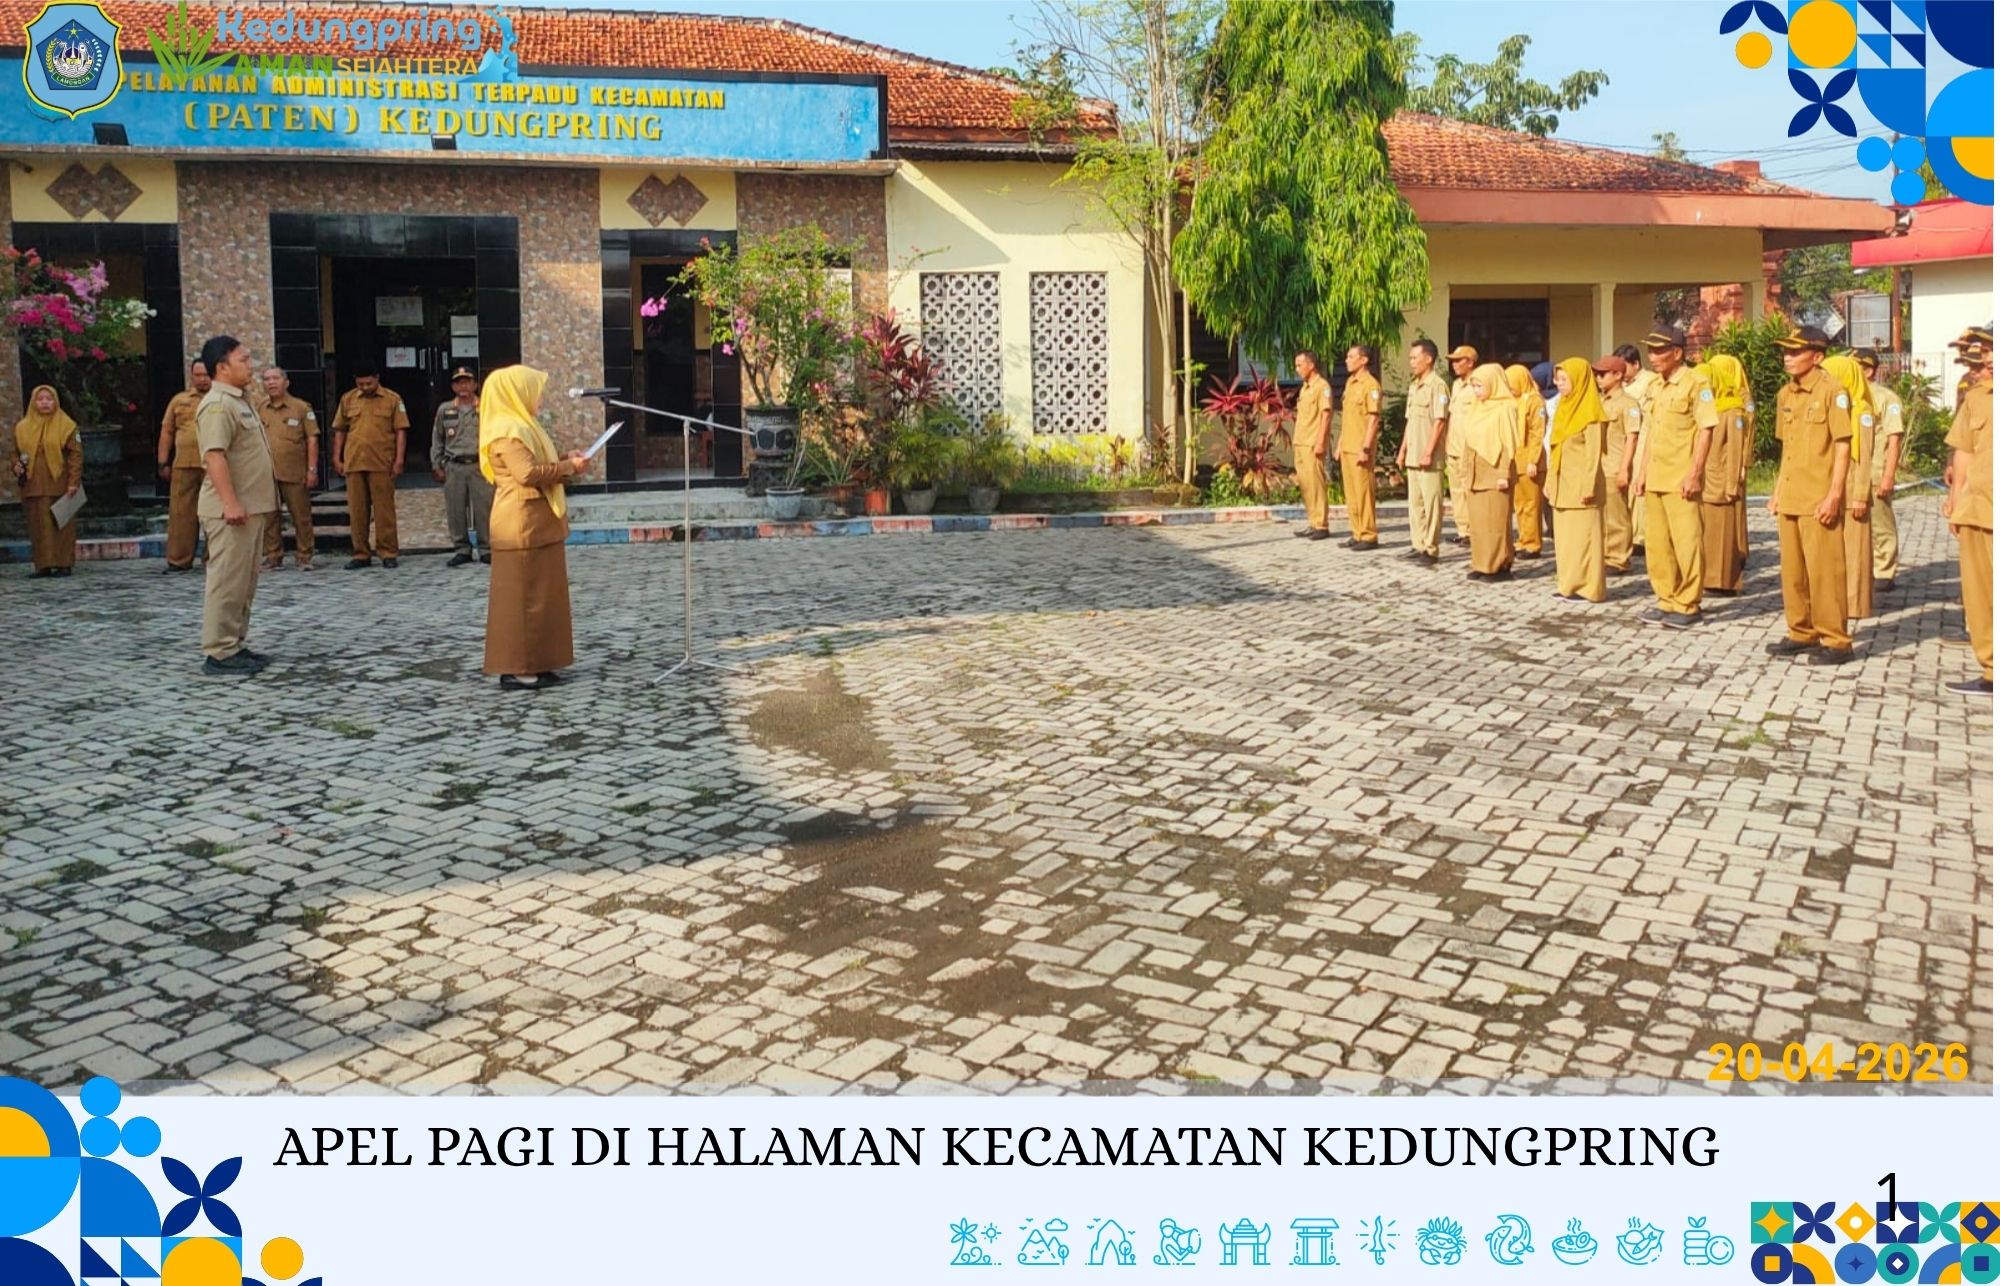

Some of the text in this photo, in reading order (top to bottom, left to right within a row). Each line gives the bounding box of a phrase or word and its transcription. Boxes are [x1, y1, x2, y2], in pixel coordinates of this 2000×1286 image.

[271, 75, 459, 101] ADMINISTRASI
[473, 82, 579, 105] TERPADU
[590, 86, 726, 110] KECAMATAN
[378, 105, 663, 141] KEDUNGPRING
